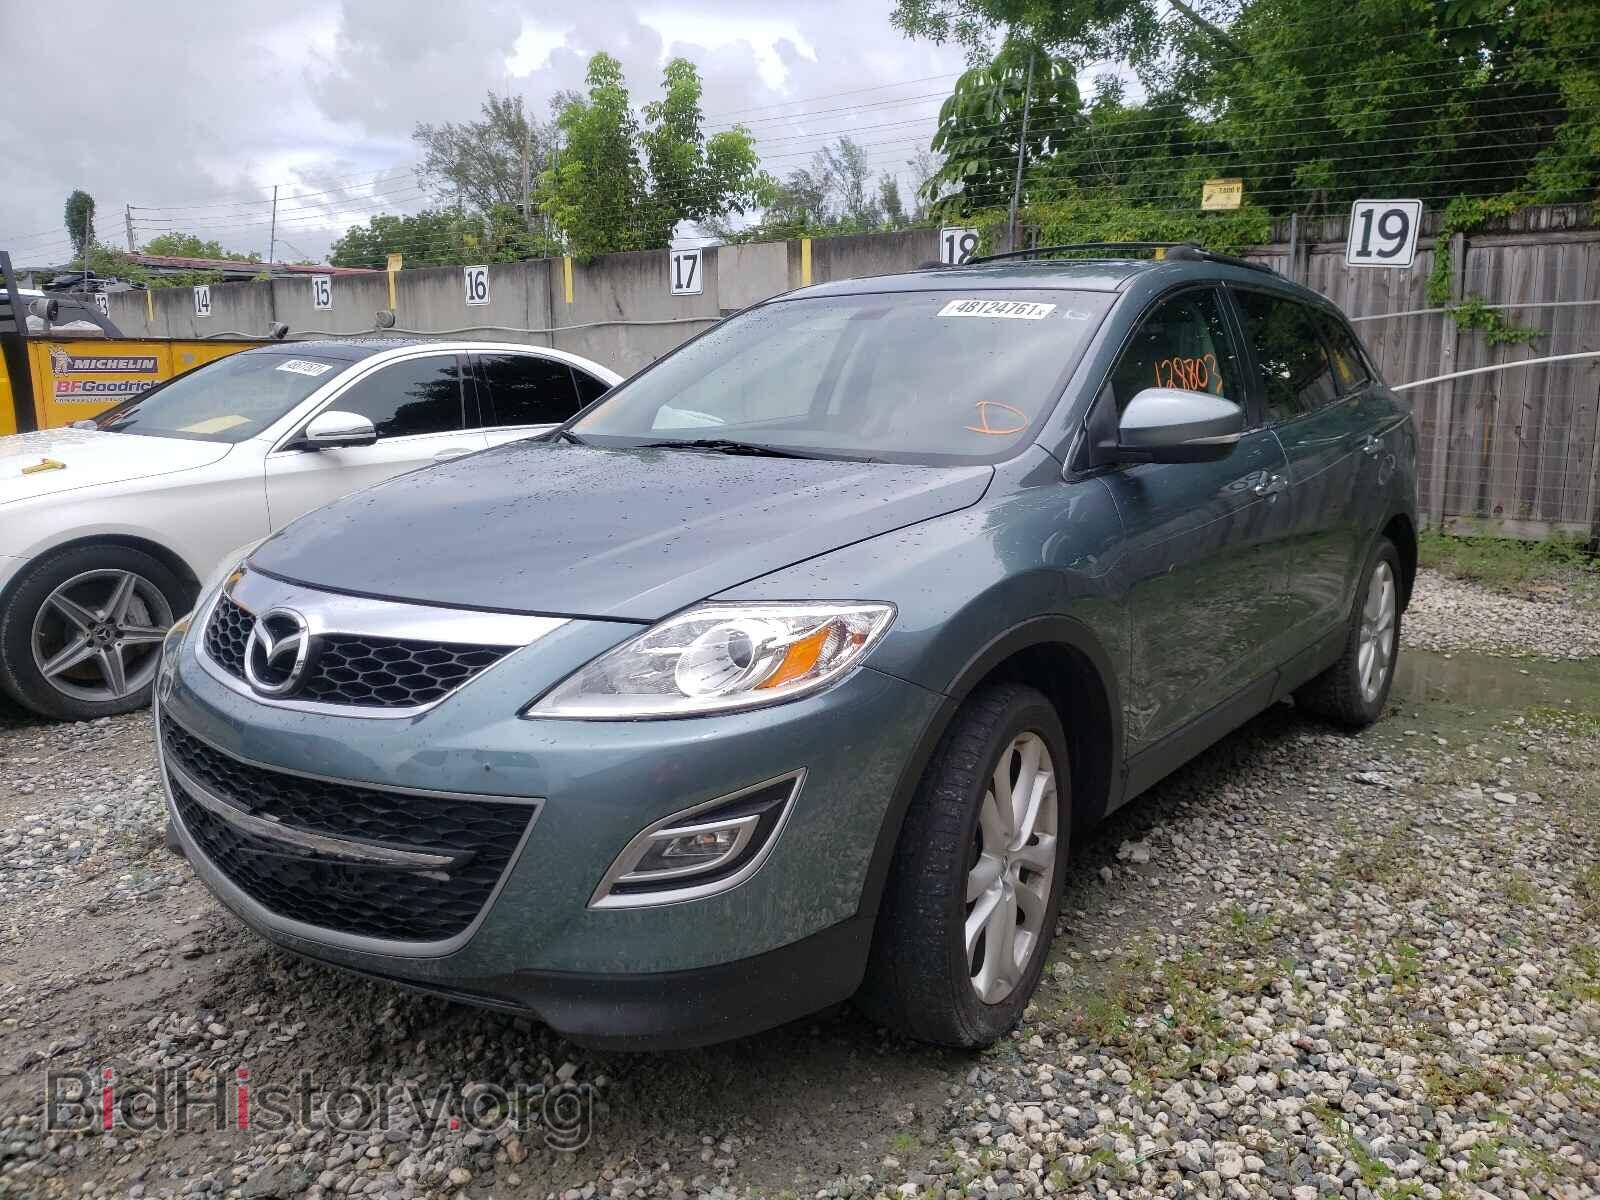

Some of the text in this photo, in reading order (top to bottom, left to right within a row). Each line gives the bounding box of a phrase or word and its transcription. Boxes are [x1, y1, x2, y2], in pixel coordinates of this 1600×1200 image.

[1355, 208, 1410, 258] 19
[673, 253, 698, 289] 17
[314, 280, 330, 306] 15
[467, 271, 487, 300] 16
[195, 289, 210, 313] 14
[73, 359, 155, 369] MICHELIN
